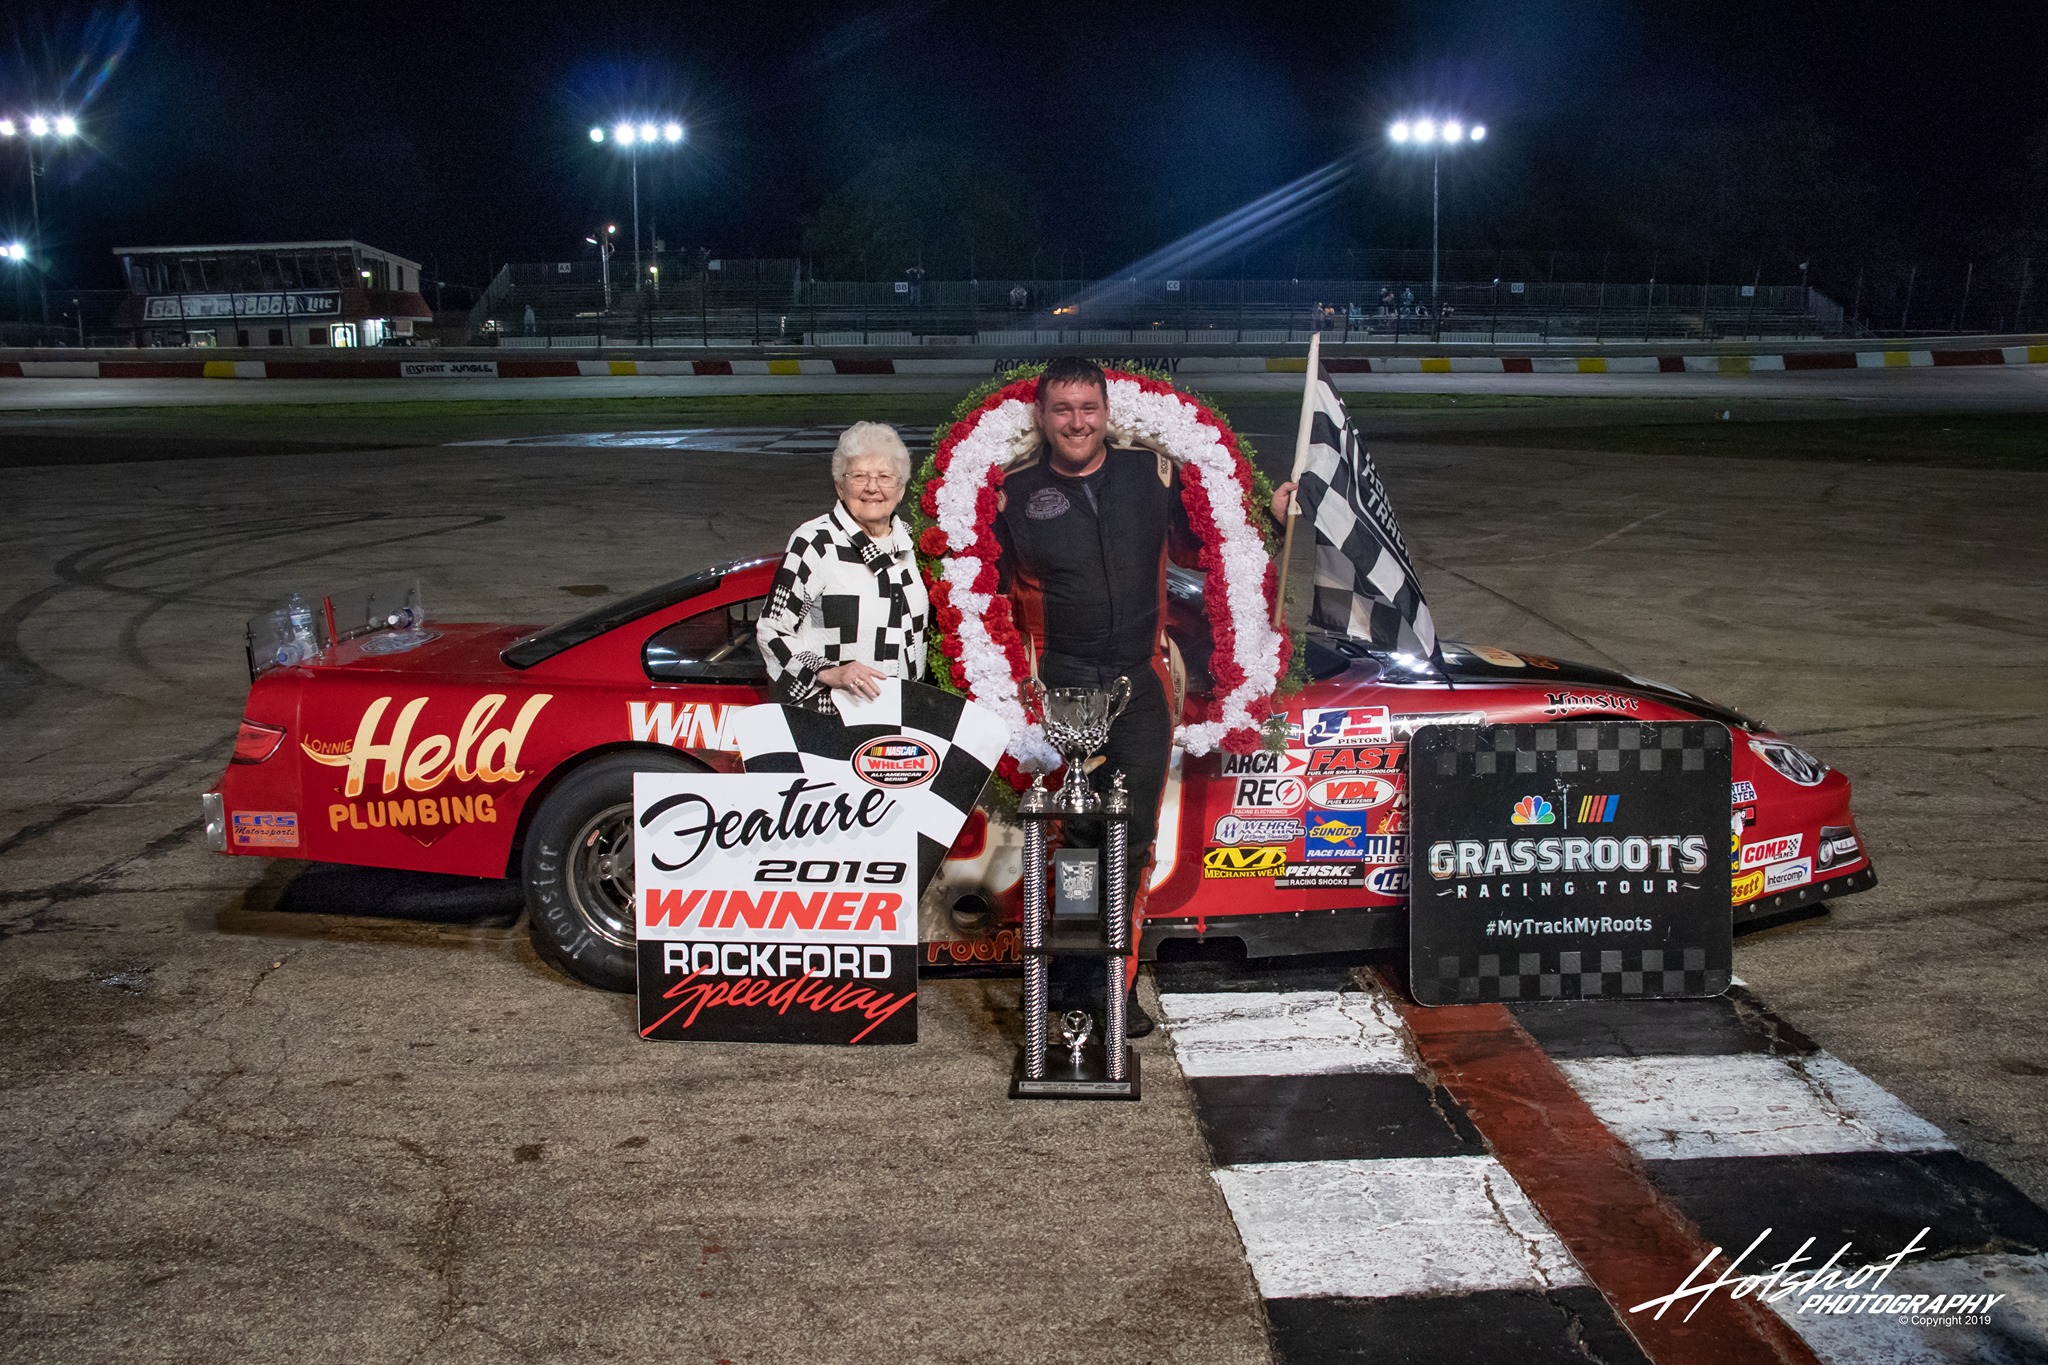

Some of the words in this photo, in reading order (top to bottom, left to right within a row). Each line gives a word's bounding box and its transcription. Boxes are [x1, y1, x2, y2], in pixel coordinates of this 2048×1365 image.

[406, 364, 445, 374] INSTANT
[450, 364, 492, 374] JUNGLE
[1542, 692, 1638, 715] Hoosier
[301, 694, 553, 797] Held
[304, 734, 353, 754] LONNIE
[1338, 736, 1388, 744] PISTONS
[885, 746, 917, 756] NASCAR
[1308, 748, 1405, 771] FAST
[868, 758, 925, 769] WHELEN
[1224, 754, 1278, 774] ARCA
[233, 814, 296, 827] CRS
[328, 794, 498, 832] PLUMBING
[234, 825, 295, 837] Motorsports
[640, 778, 896, 871] Feature
[1243, 820, 1299, 830] WEHRS
[1310, 827, 1360, 837] SUNOCO
[1335, 849, 1364, 857] FUELS
[1428, 834, 1708, 881] GRASSROOTS
[1743, 840, 1788, 863] COMP
[1773, 851, 1794, 861] CAMS
[754, 860, 907, 884] 2019
[1205, 869, 1256, 879] MECHANIX
[1257, 867, 1286, 877] WEAR
[1284, 865, 1357, 877] PENSKE
[1767, 870, 1803, 885] Intercomp
[1318, 878, 1348, 886] SHOCKS
[1457, 881, 1575, 899] RACING
[1596, 880, 1678, 895] TOUR
[646, 890, 902, 932] WINNER
[1486, 916, 1652, 939] #MyTrackMyRoots
[664, 943, 892, 979] ROCKFORD
[640, 965, 917, 1044] Speedway
